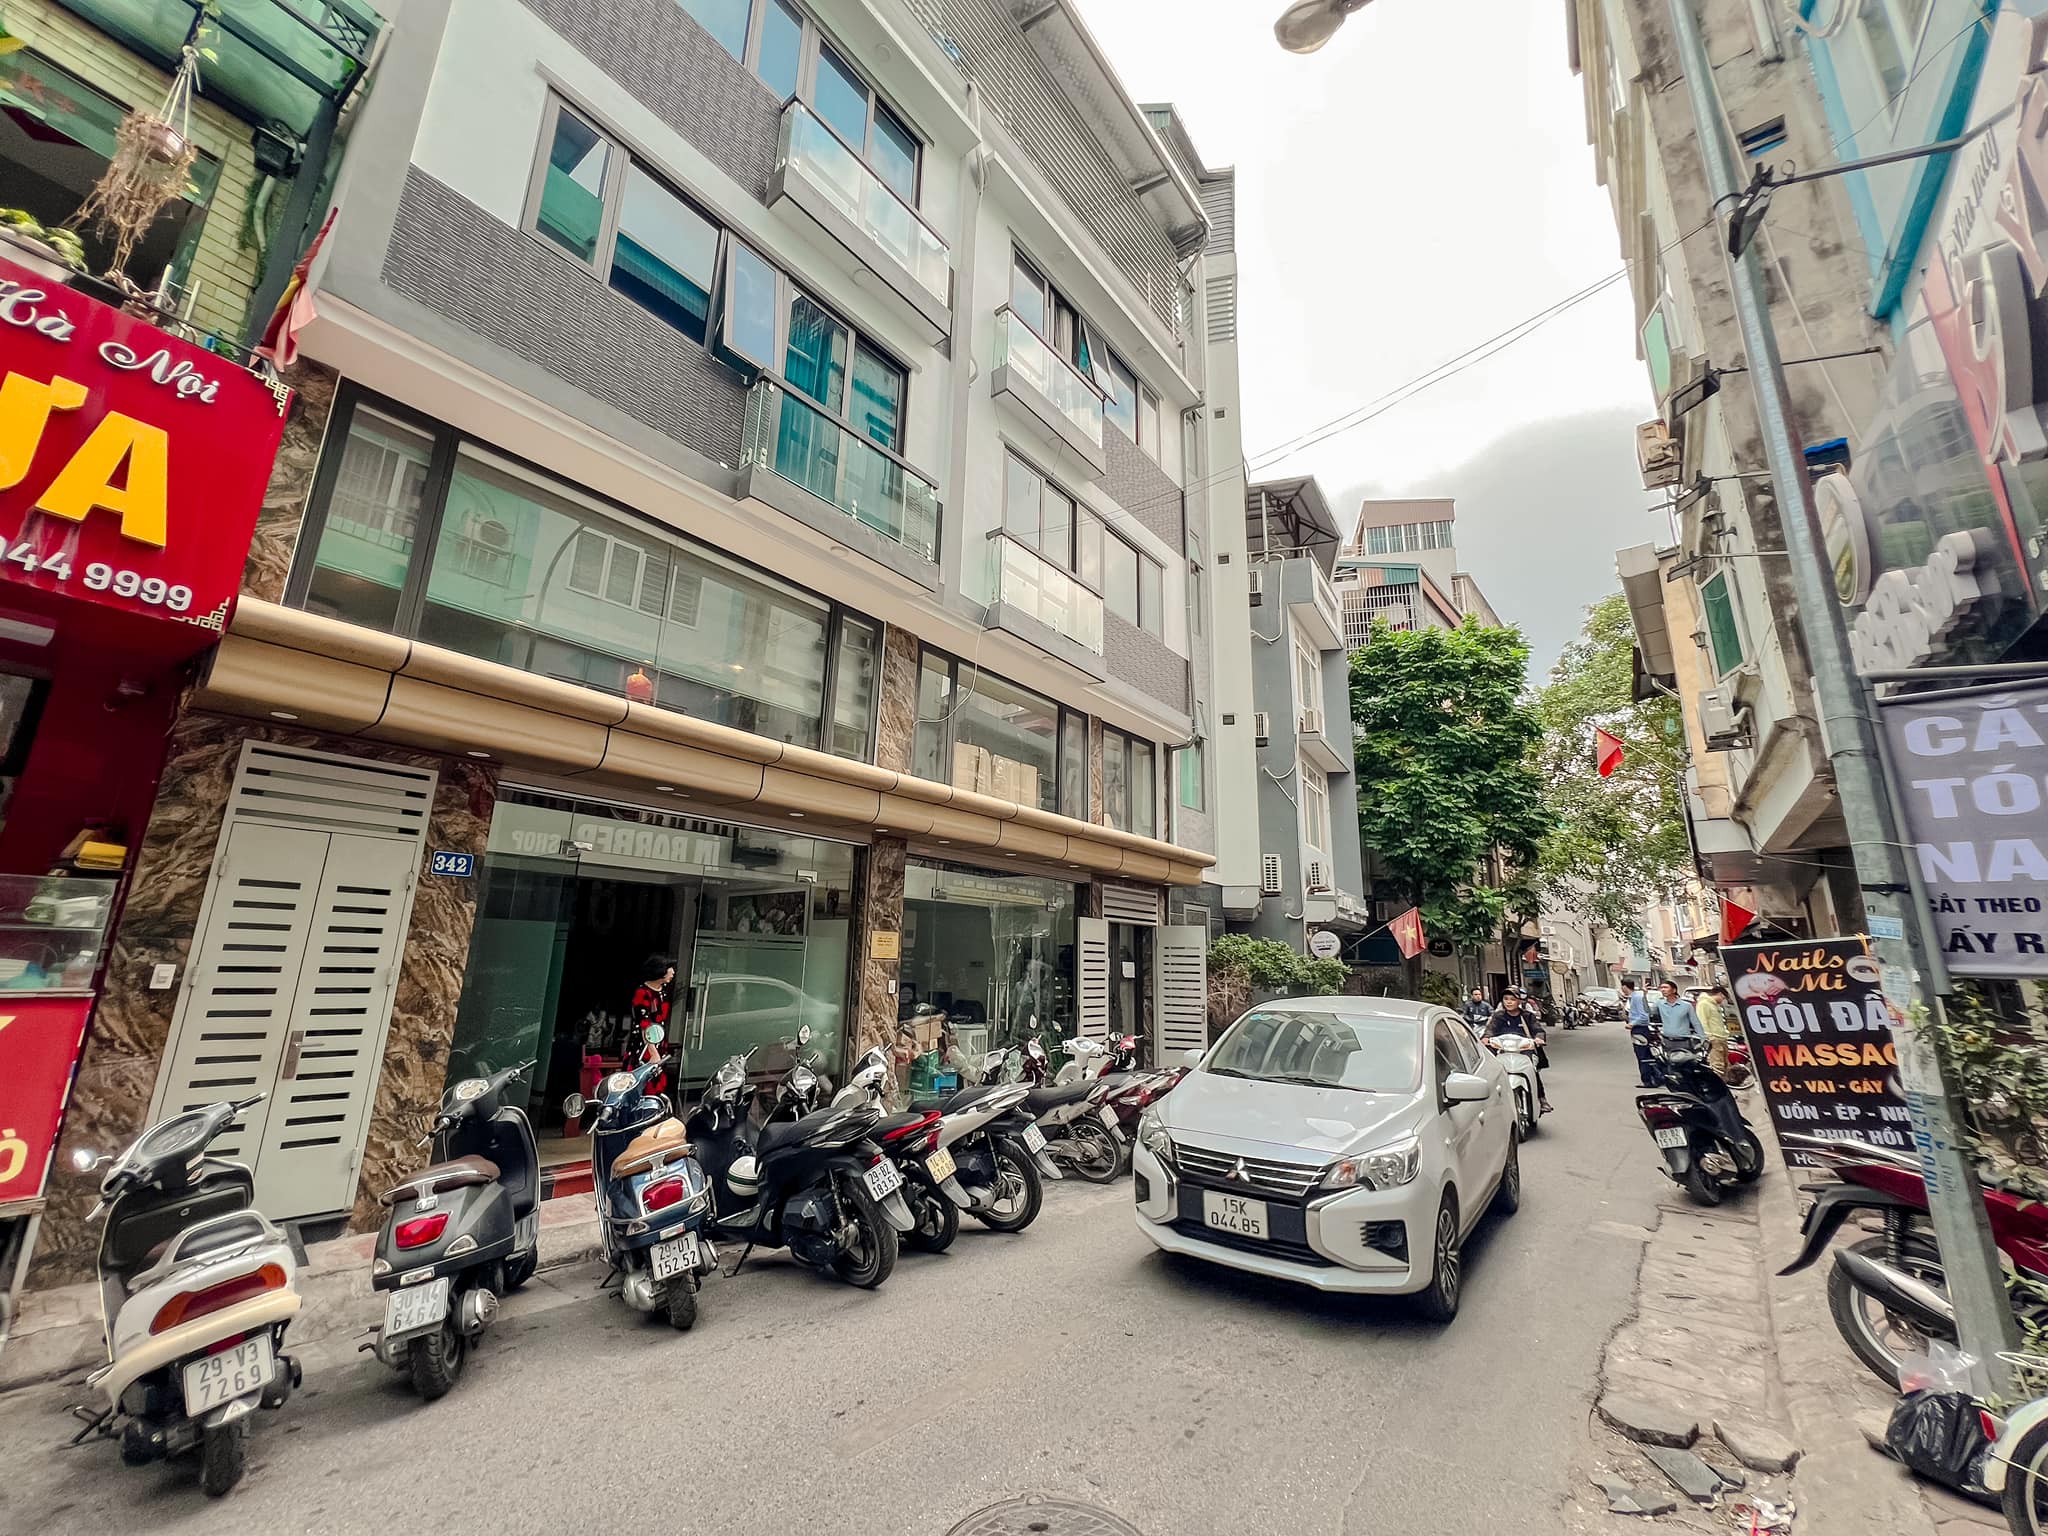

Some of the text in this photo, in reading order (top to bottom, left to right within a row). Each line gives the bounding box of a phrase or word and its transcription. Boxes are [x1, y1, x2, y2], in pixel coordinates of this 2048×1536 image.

[98, 341, 221, 404] Nội
[83, 562, 193, 611] 9999
[1904, 693, 2048, 756] CẮ
[1912, 763, 2048, 818] TÓ
[434, 855, 467, 873] 342
[1973, 897, 2041, 914] THEO
[1941, 924, 1998, 954] ẤY
[1747, 948, 1845, 974] Nails
[1789, 973, 1848, 993] Mi
[1746, 997, 1821, 1040] GỘI
[1804, 1080, 1837, 1094] VAI
[1835, 1103, 1862, 1121] ÉP
[1223, 1197, 1247, 1216] 15K
[1211, 1211, 1260, 1235] 044.85
[658, 1250, 697, 1277] 152.52
[199, 1342, 258, 1384] 29-V3
[200, 1364, 261, 1408] 7269
